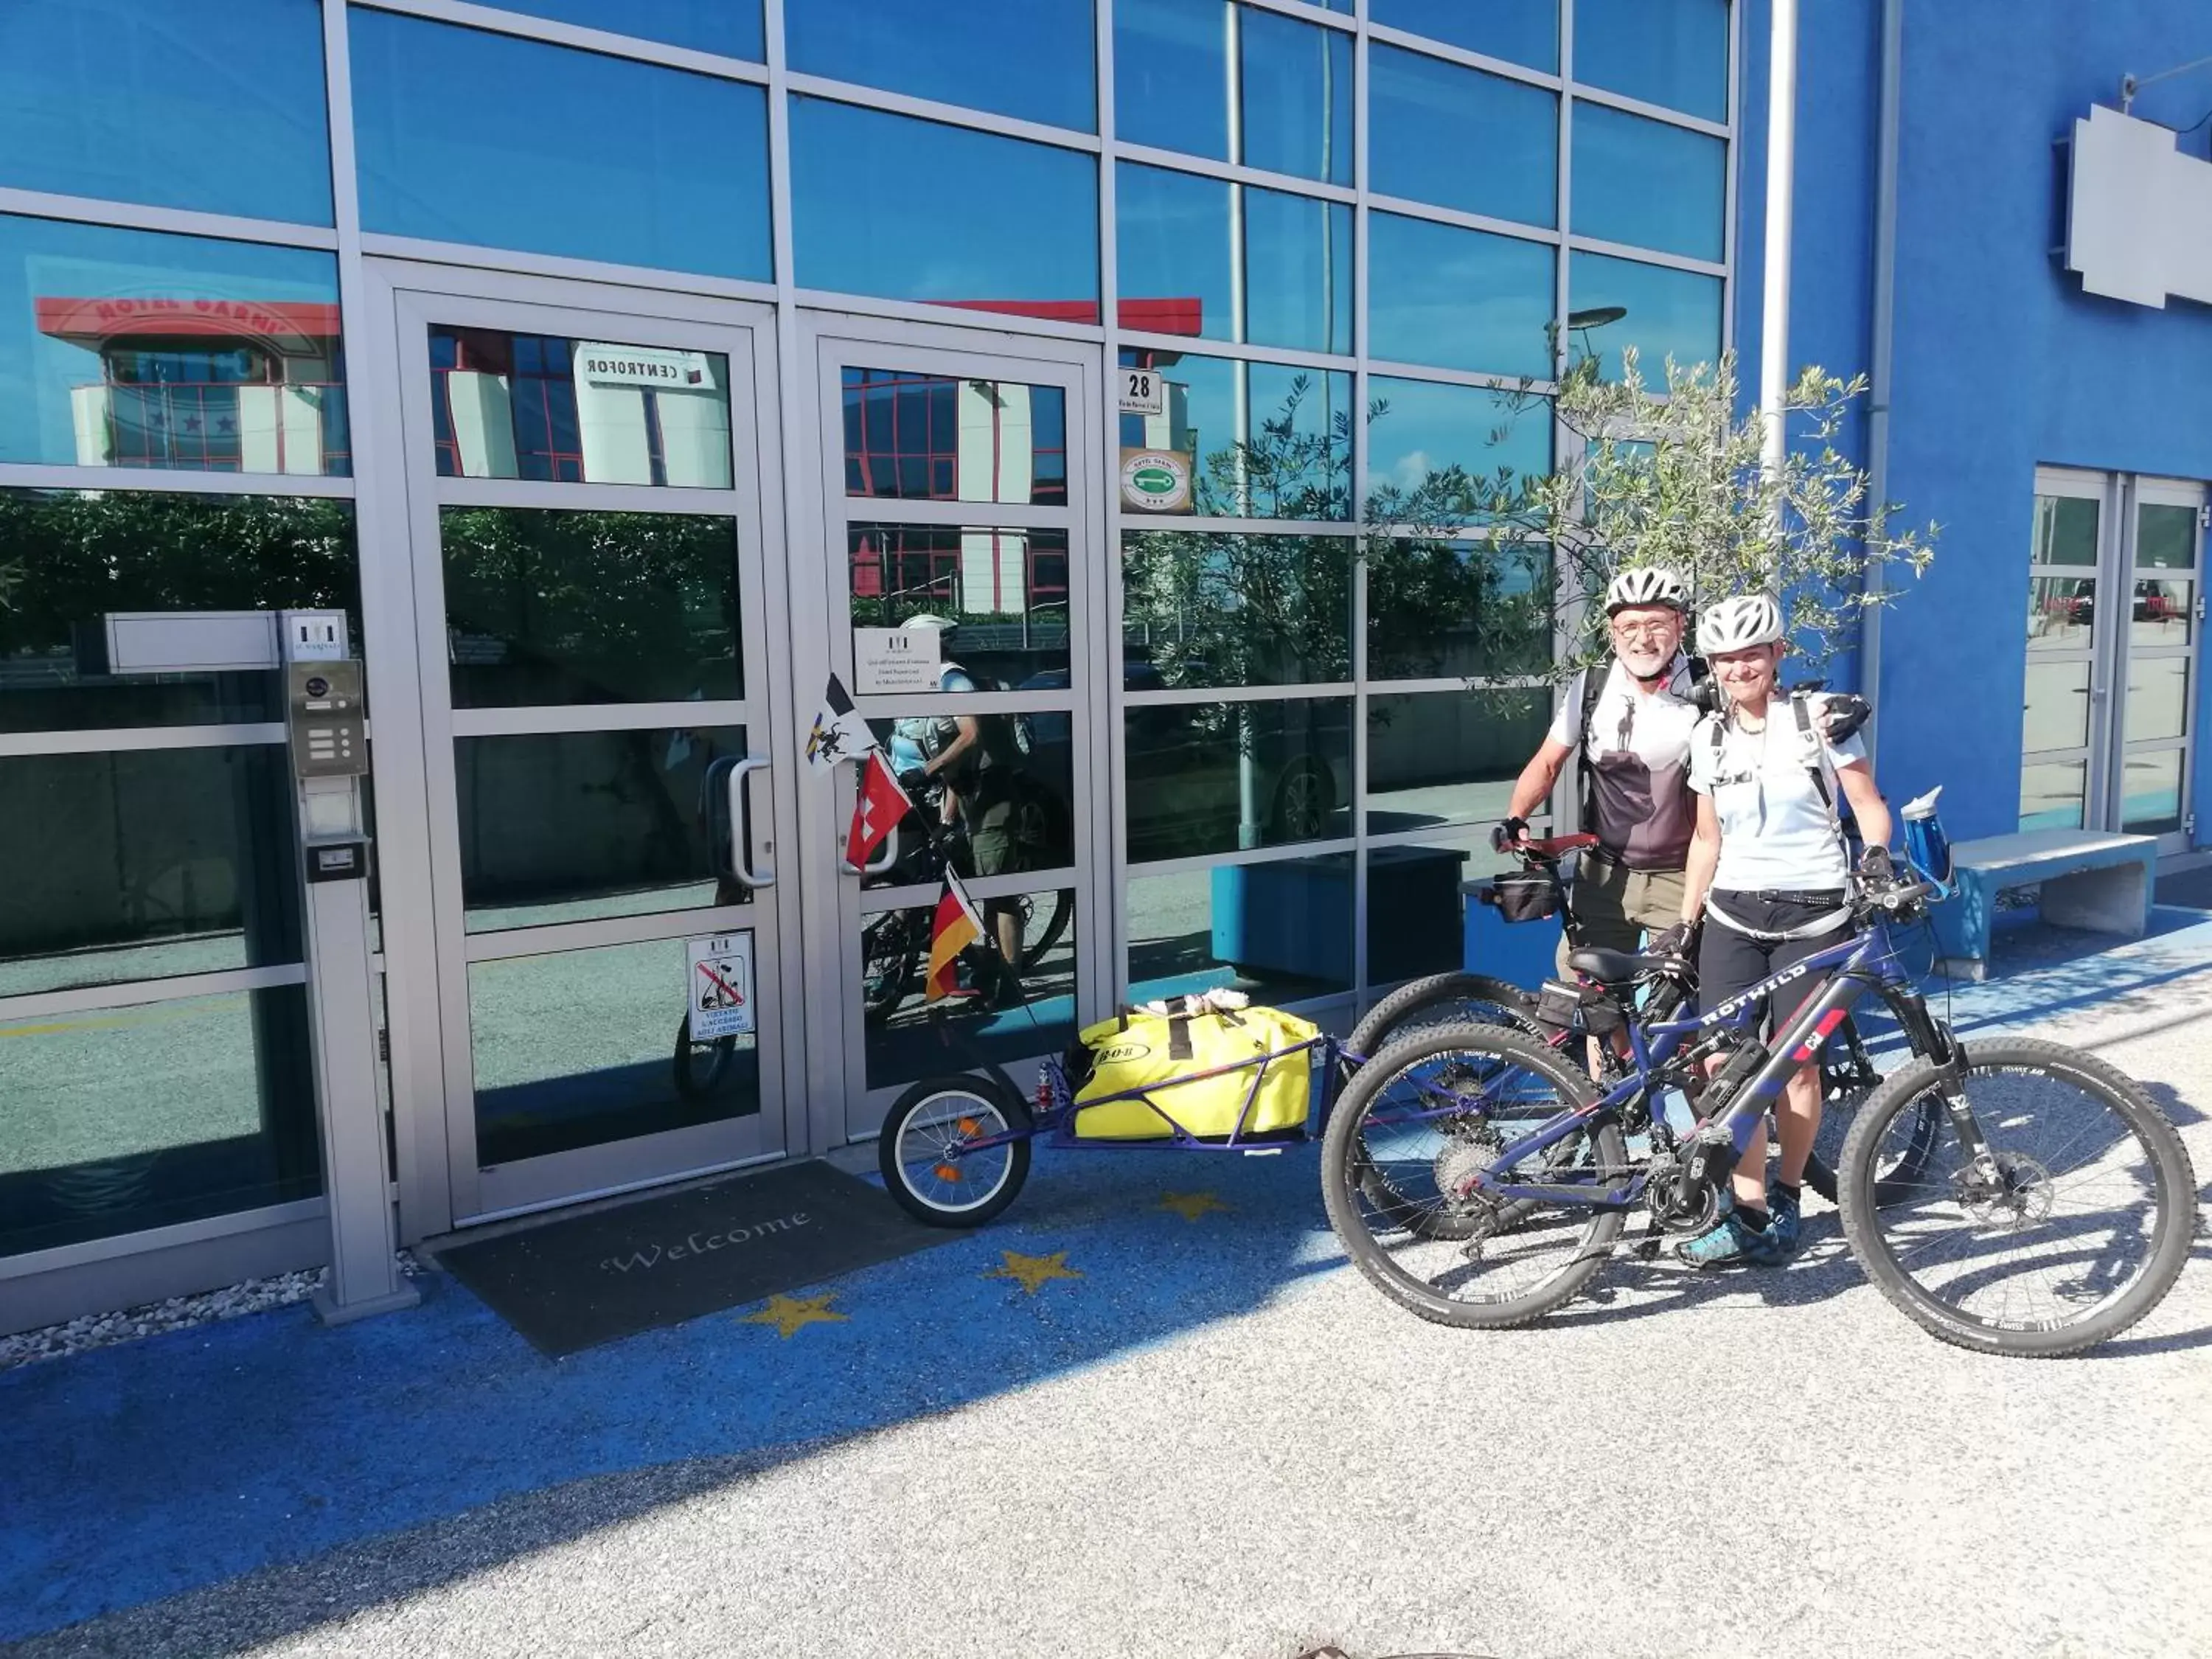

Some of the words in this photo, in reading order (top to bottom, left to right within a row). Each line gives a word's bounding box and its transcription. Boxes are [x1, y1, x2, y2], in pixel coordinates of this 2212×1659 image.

[97, 293, 179, 321] HOTEL
[1129, 375, 1150, 397] 28
[1700, 964, 1807, 1026] ROTWILD
[1947, 1093, 1970, 1111] 32
[599, 1211, 813, 1274] Welcome
